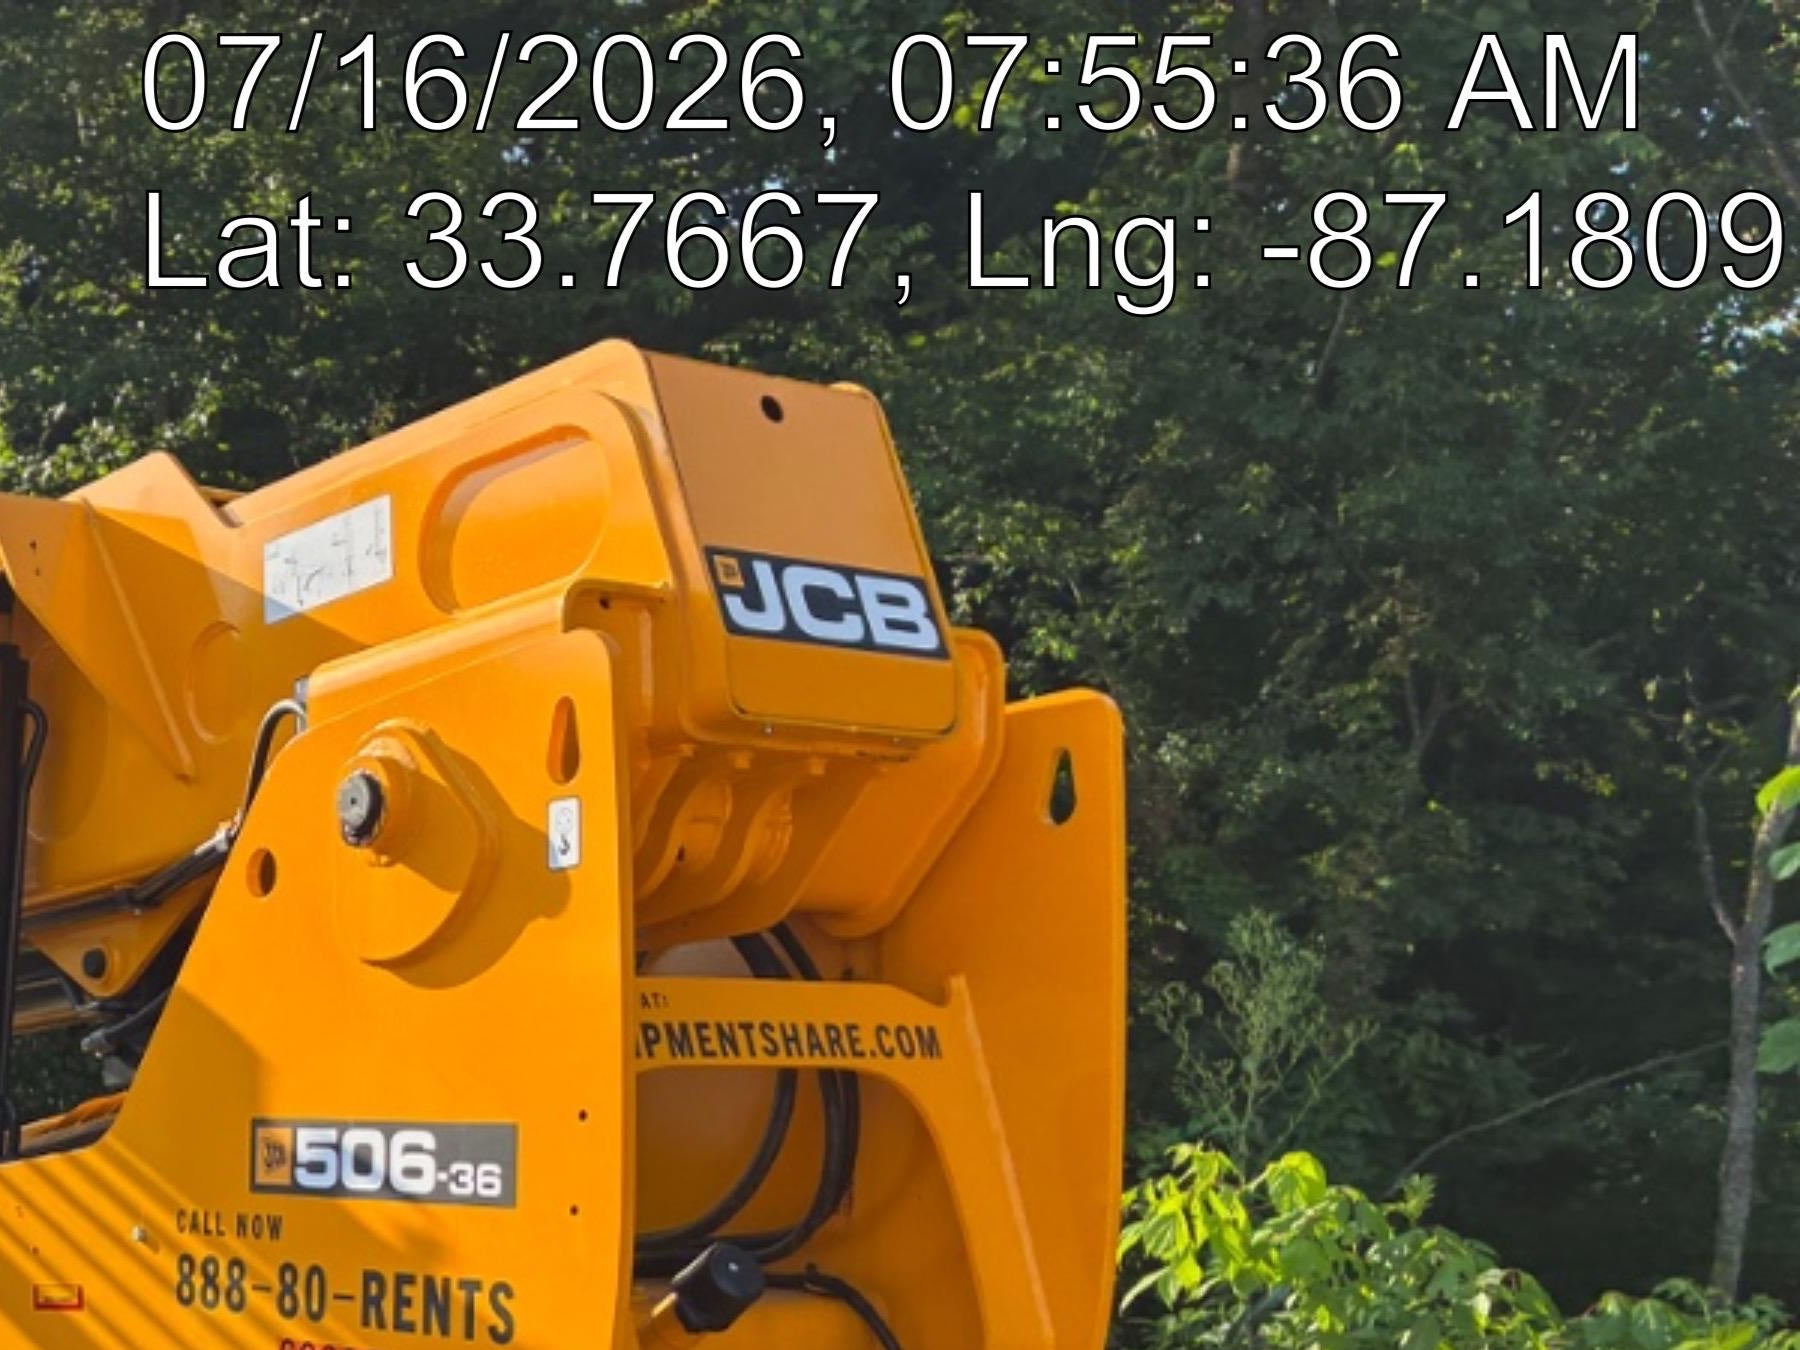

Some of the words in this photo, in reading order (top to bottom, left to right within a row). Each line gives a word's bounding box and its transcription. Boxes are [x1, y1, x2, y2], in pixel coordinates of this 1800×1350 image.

[723, 559, 941, 651] JCB
[294, 1126, 503, 1198] 506-36
[176, 1208, 226, 1238] CALL
[236, 1213, 284, 1241] NOW
[175, 1252, 515, 1346] 888-80-RENTS
